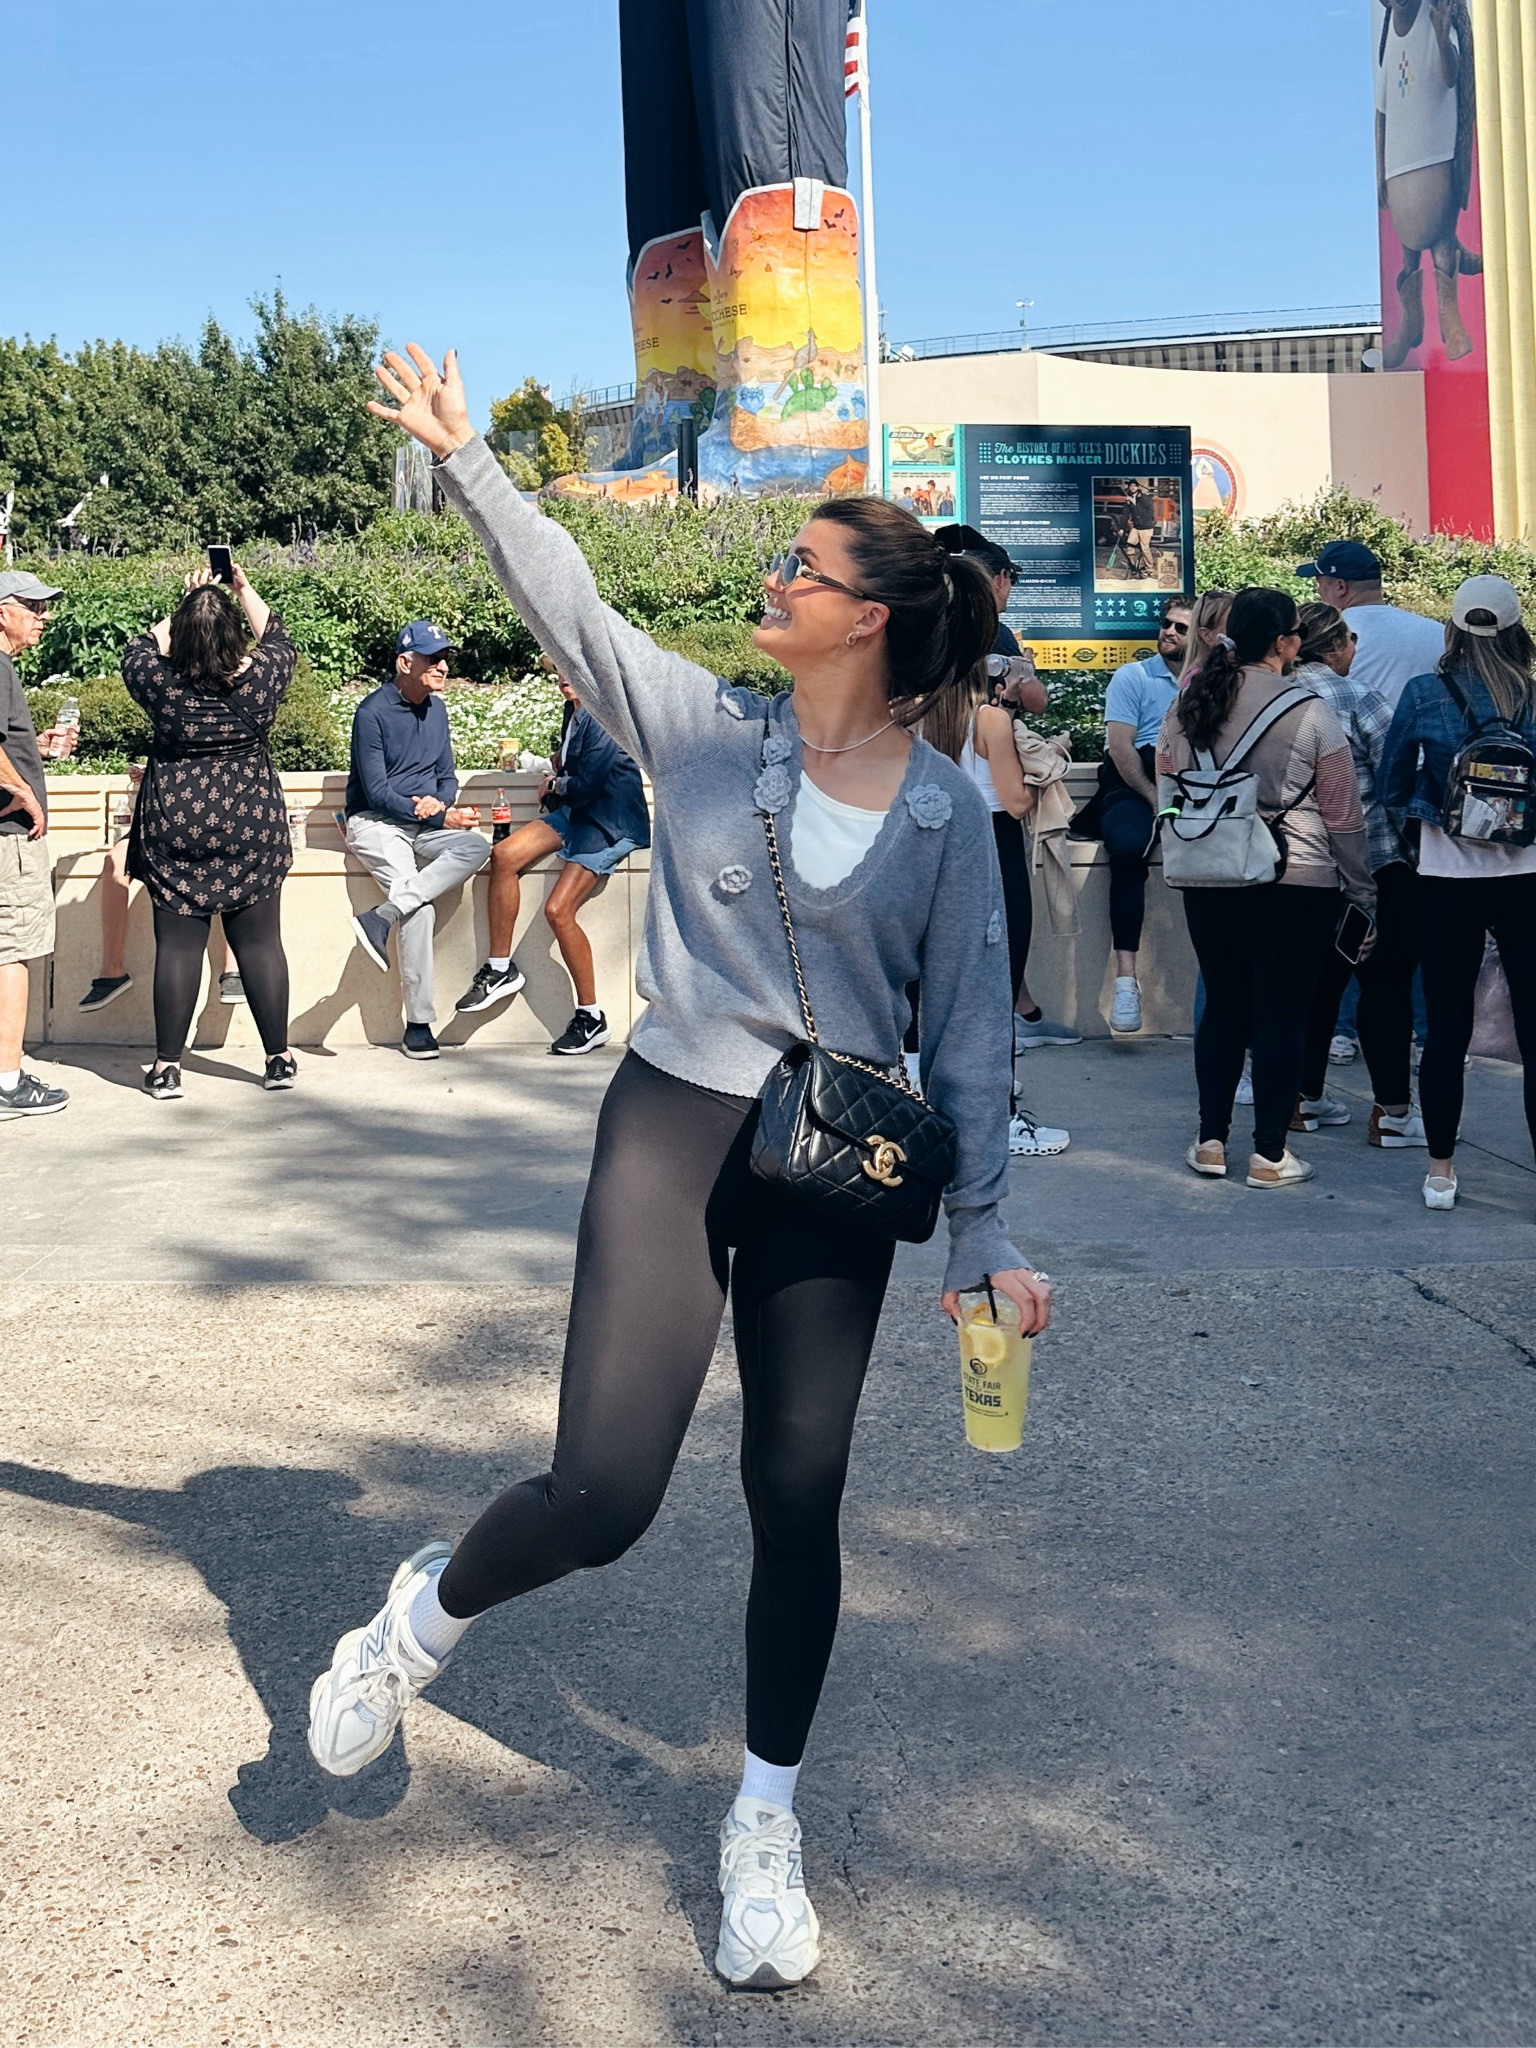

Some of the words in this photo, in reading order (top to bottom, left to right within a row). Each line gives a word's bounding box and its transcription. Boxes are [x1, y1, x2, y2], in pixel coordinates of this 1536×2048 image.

[994, 442, 1014, 453] The
[1017, 442, 1048, 453] HISTORY
[1051, 442, 1060, 453] OF
[1063, 442, 1077, 453] BIG
[1105, 443, 1167, 465] DICKIES
[994, 455, 1053, 465] CLOTHES
[1056, 455, 1102, 465] MAKER
[427, 625, 442, 639] T
[29, 1089, 46, 1104] N
[982, 1380, 1001, 1390] FAIR
[964, 1385, 1002, 1407] TEXAS
